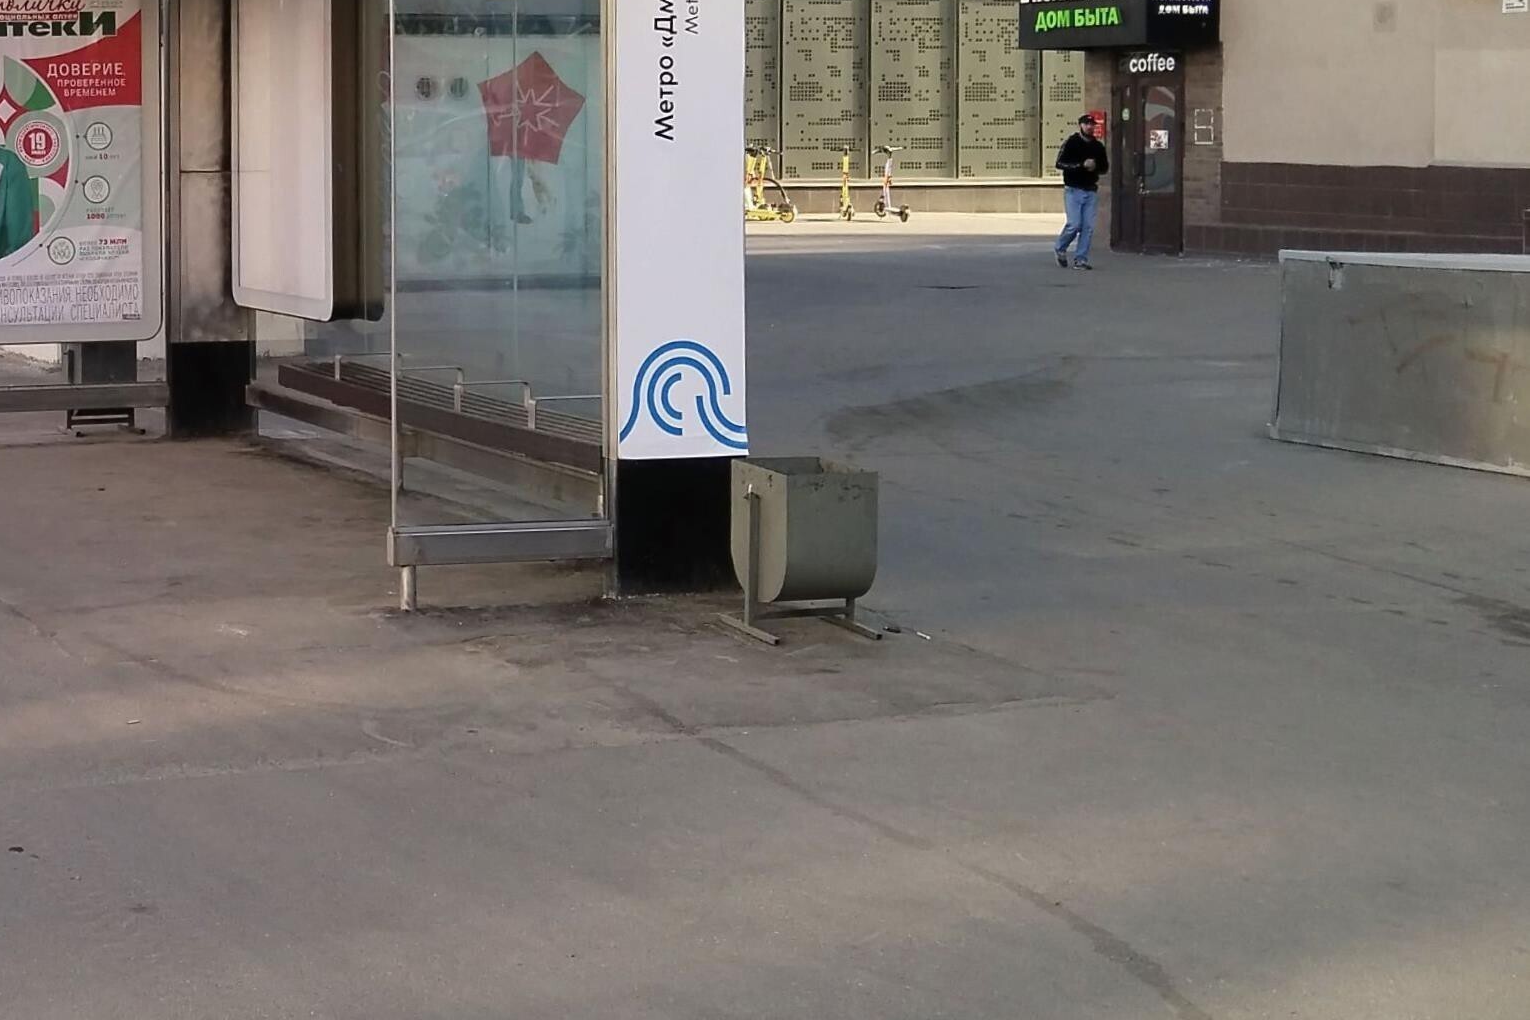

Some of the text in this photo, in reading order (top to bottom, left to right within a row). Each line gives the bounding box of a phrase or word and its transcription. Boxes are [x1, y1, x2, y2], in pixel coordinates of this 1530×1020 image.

[1035, 7, 1120, 32] ДОМ БЫТА
[1129, 53, 1175, 73] coffee
[57, 78, 126, 87] ПРОВЕРЕННОЕ
[64, 88, 116, 97] ВРЕМЕНЕМ
[654, 55, 678, 141] Метро
[29, 132, 46, 150] 19
[76, 284, 139, 302] НЕОБХОДИМО
[70, 302, 139, 322] СПЕЦИАЛИСТА
